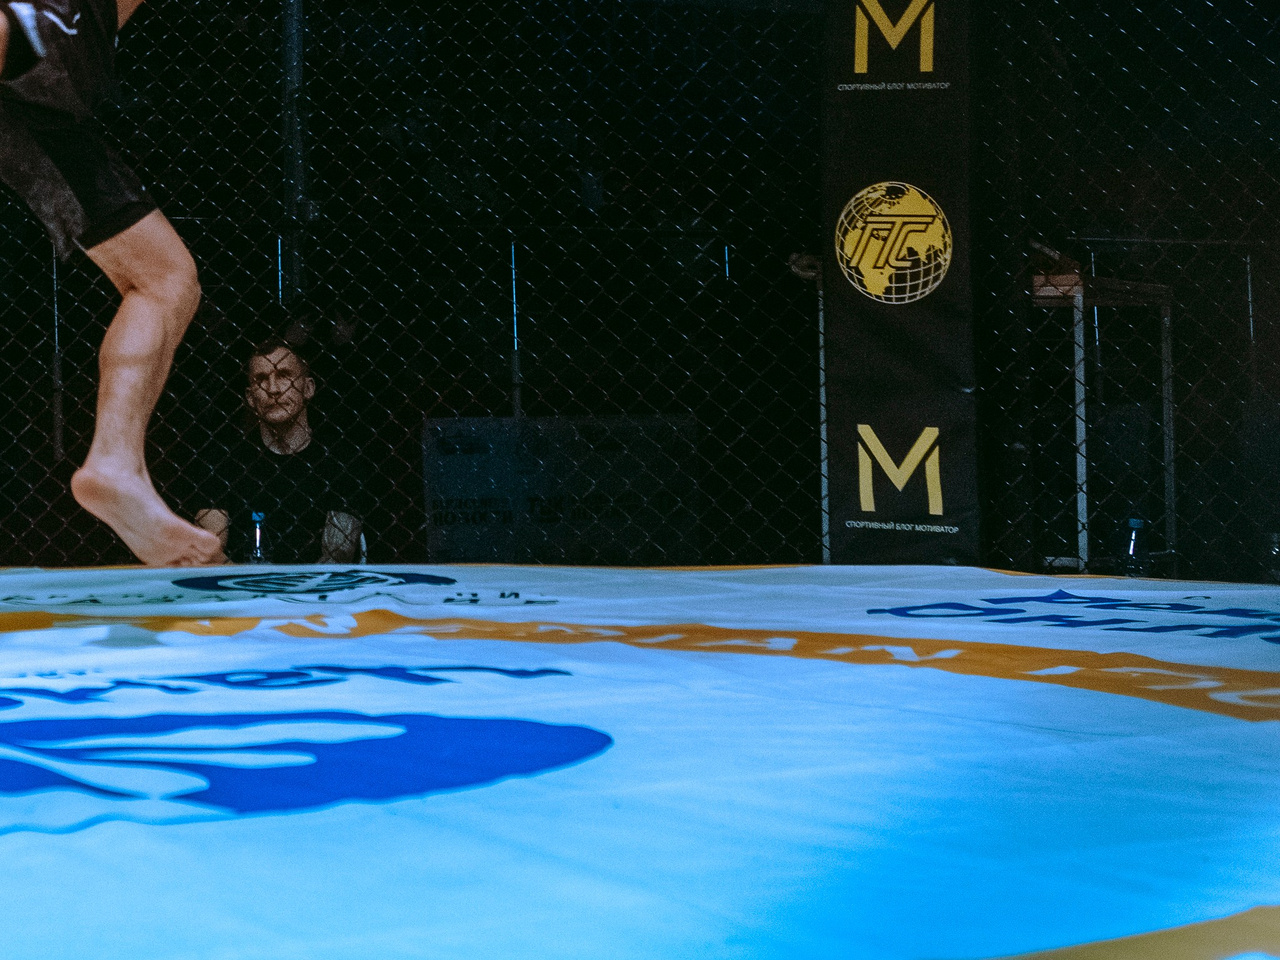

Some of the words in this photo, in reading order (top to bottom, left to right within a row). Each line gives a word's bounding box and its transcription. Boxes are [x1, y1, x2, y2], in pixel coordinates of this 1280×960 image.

[845, 520, 895, 530] СПОРТИВНЫЙ
[896, 523, 914, 531] БЛОГ
[915, 525, 959, 534] МОТИВАТОР
